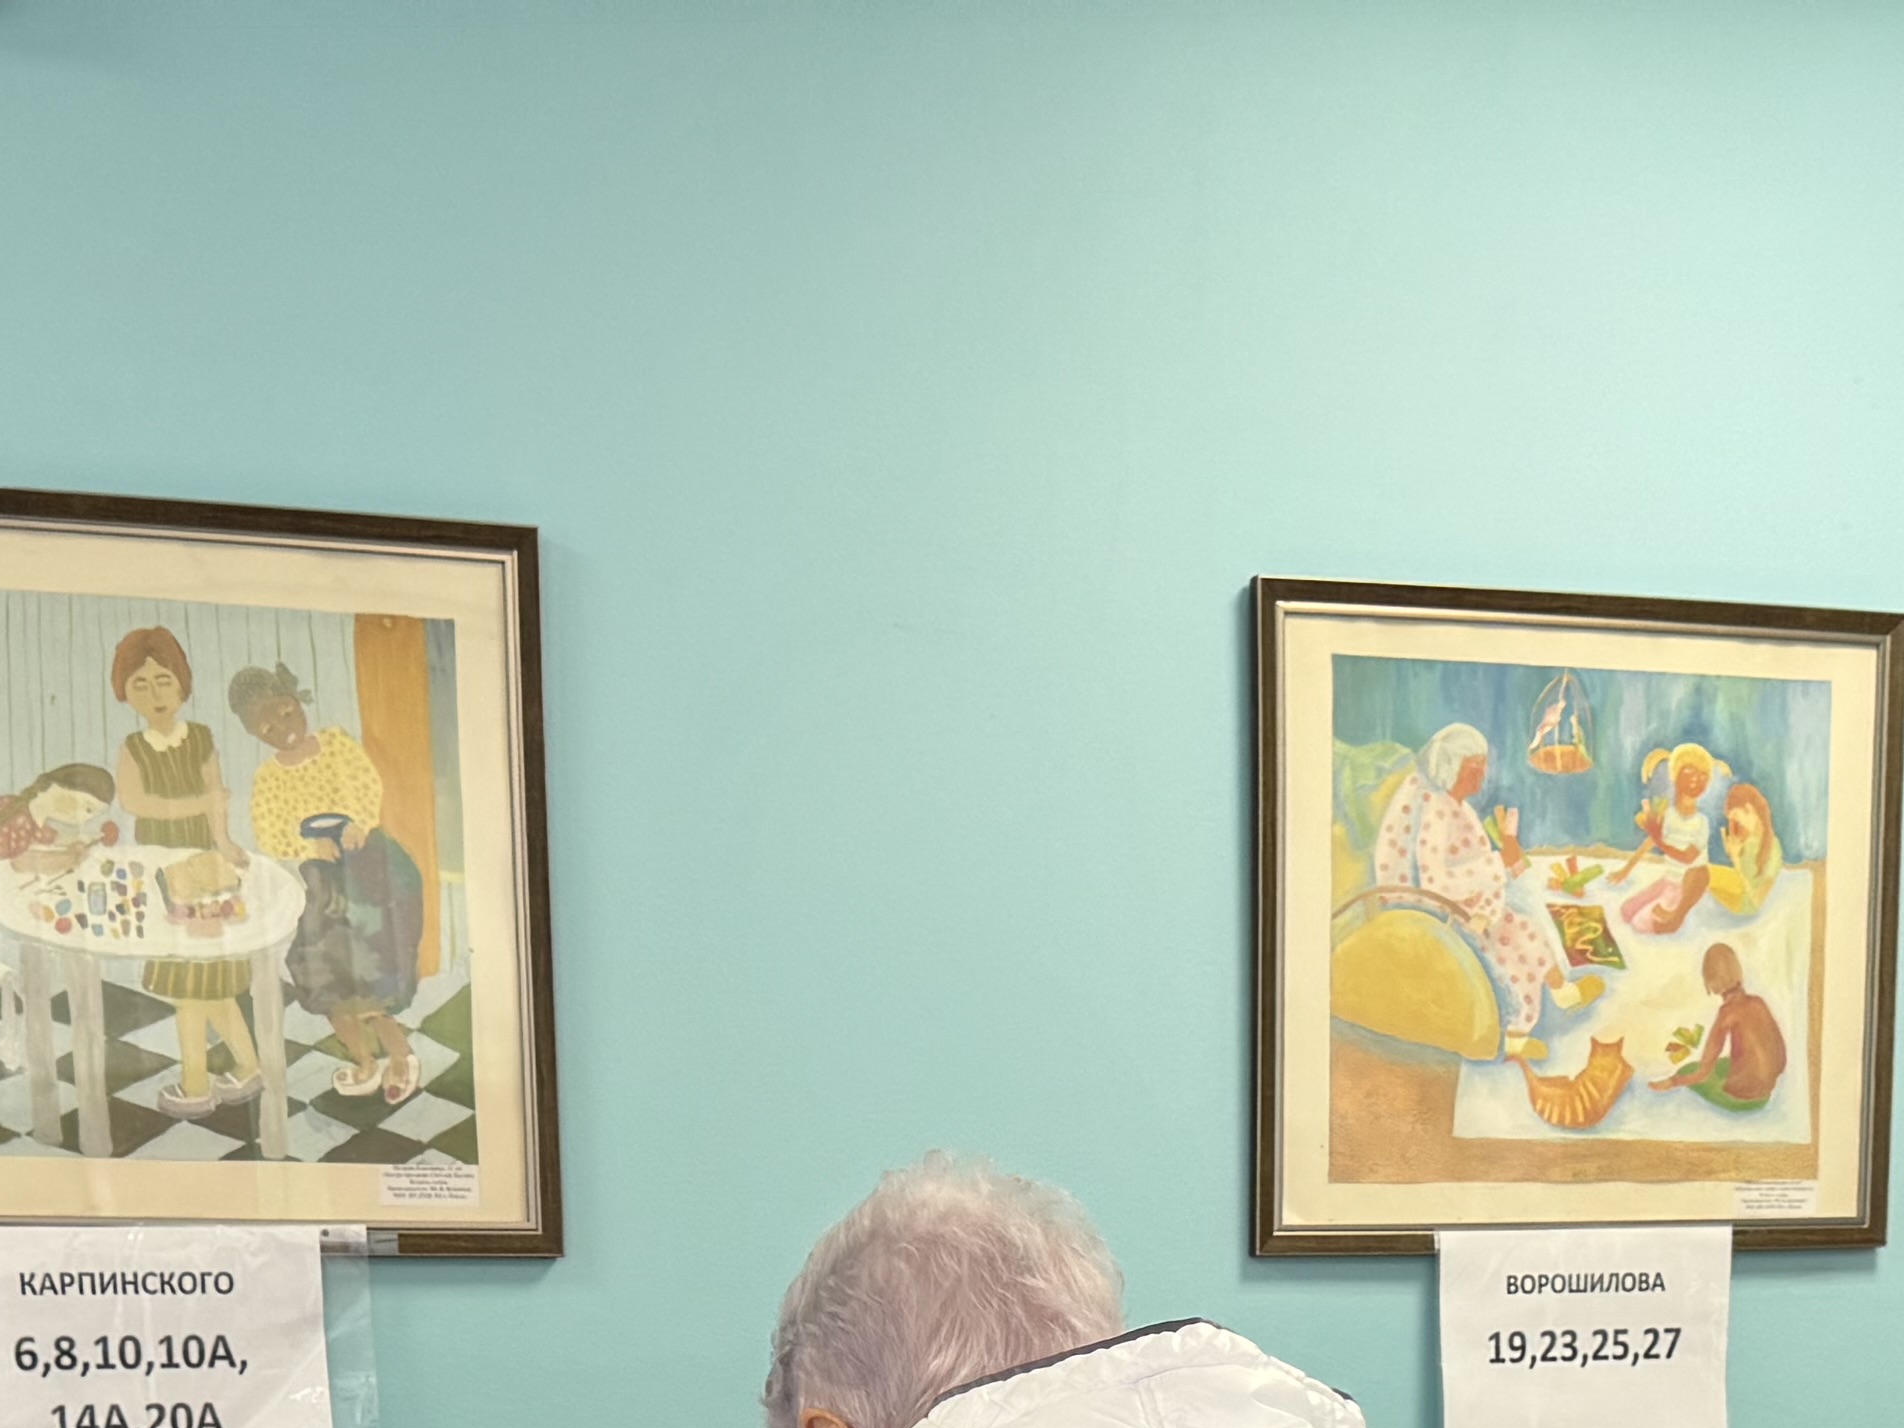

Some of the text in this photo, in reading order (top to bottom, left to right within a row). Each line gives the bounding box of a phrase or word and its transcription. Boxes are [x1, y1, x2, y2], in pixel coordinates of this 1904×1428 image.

[18, 1270, 236, 1297] КАРПИНСКОГО
[1506, 1271, 1667, 1295] ВОРОШИЛОВА
[13, 1333, 249, 1378] 6,8,10,10А,
[1487, 1327, 1683, 1370] 19,23,25,27
